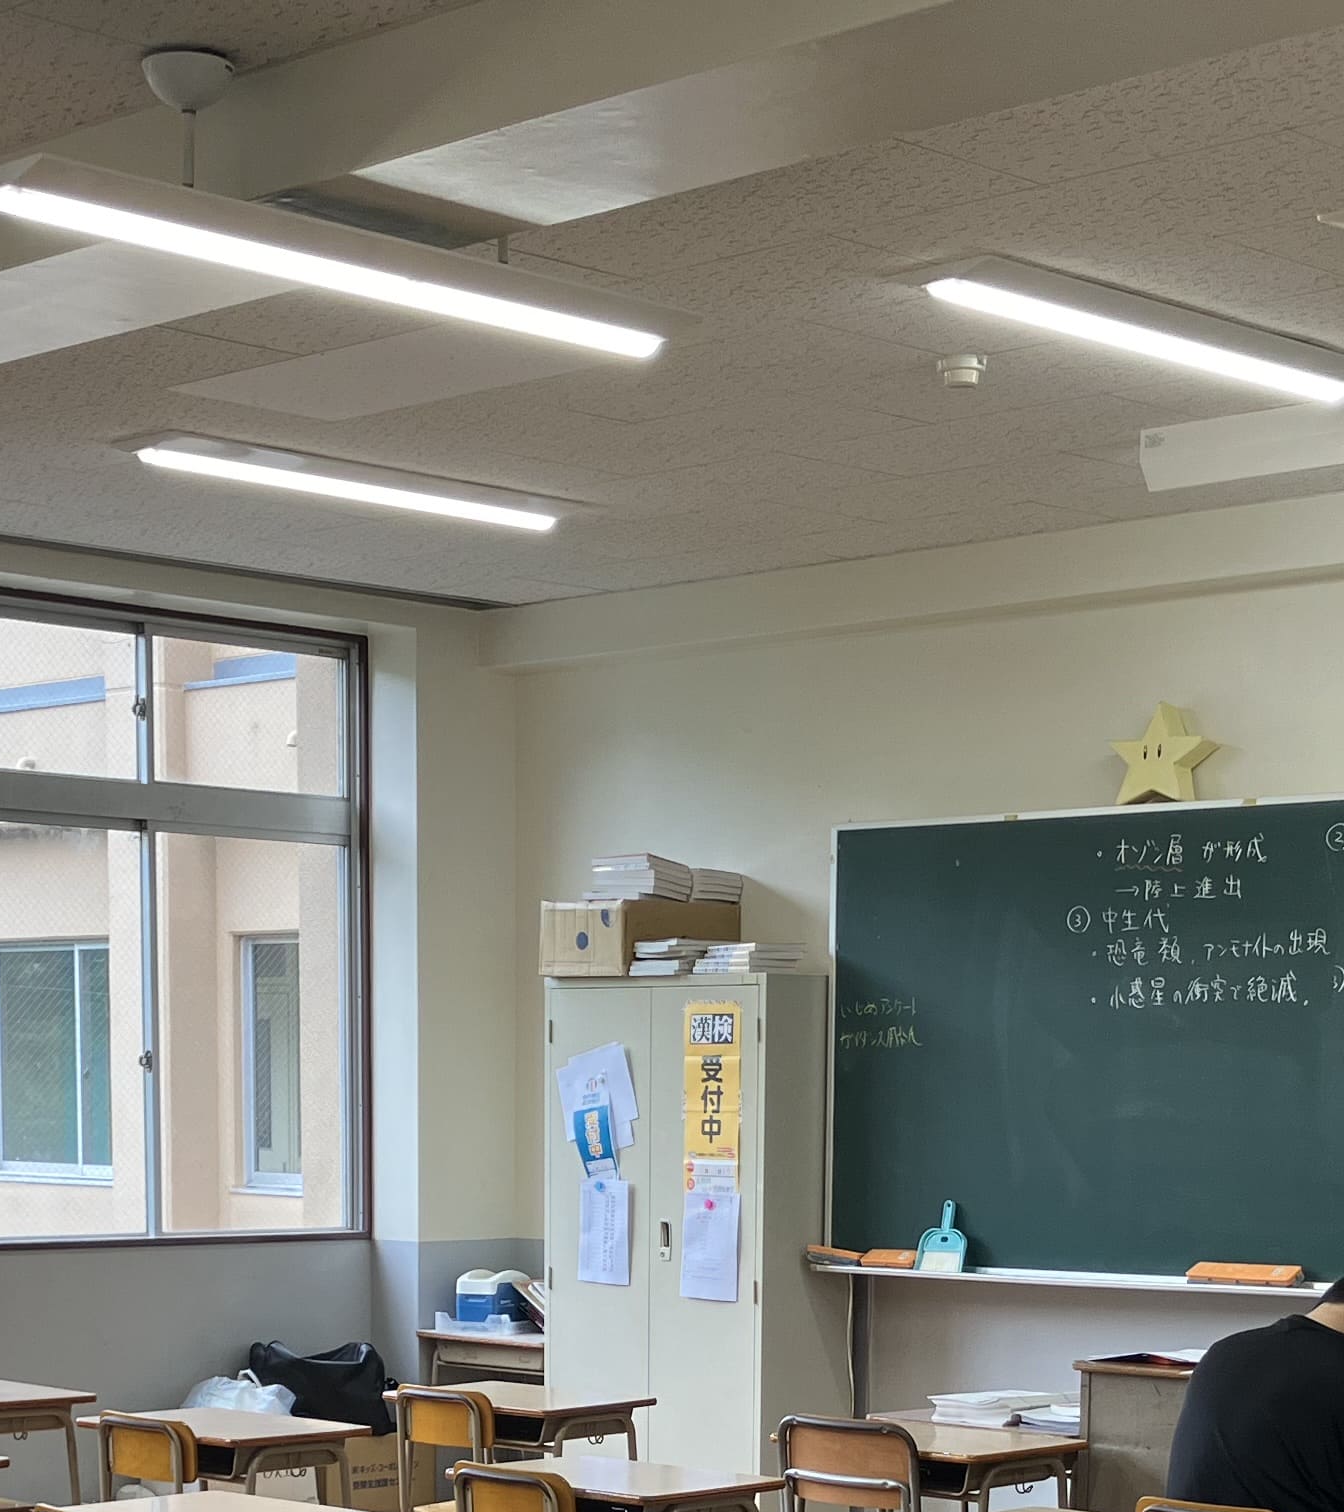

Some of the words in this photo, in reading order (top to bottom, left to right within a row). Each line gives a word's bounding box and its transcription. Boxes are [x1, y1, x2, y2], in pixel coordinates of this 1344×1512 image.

[1101, 903, 1171, 933] 中生代
[691, 1014, 734, 1044] 漢検
[701, 1055, 724, 1144] 受付中
